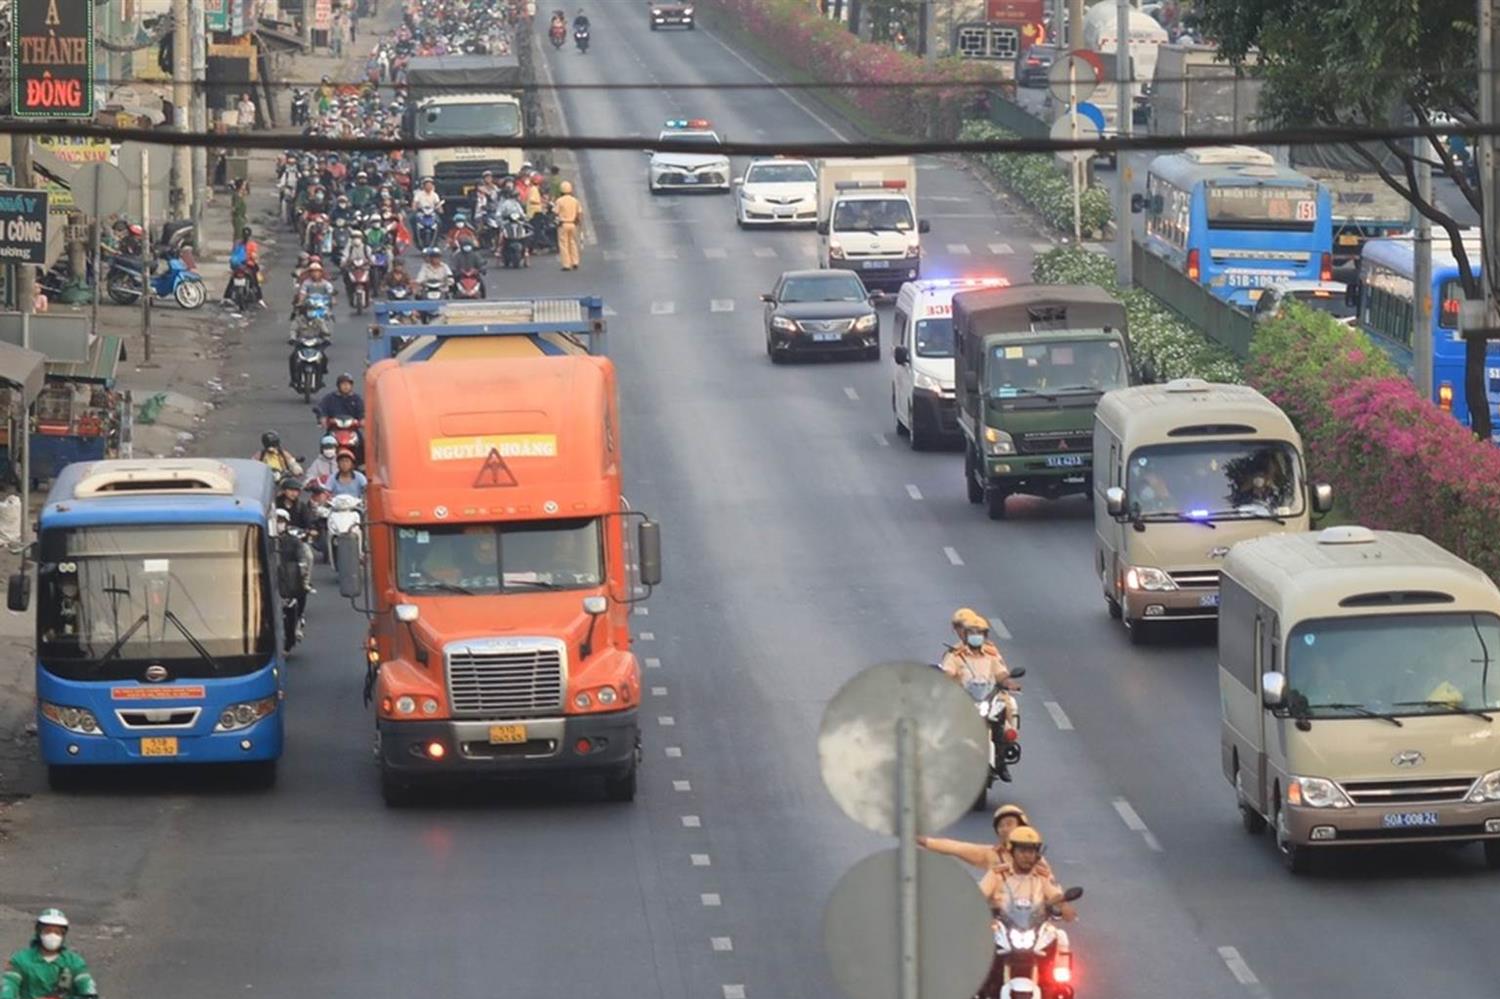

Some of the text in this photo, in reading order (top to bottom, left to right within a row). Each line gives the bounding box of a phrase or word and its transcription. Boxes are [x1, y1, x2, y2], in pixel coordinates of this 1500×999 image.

[20, 28, 87, 65] THÀNH
[27, 70, 82, 107] ĐÔNG
[1298, 201, 1316, 220] 151
[7, 215, 43, 242] CÔNG
